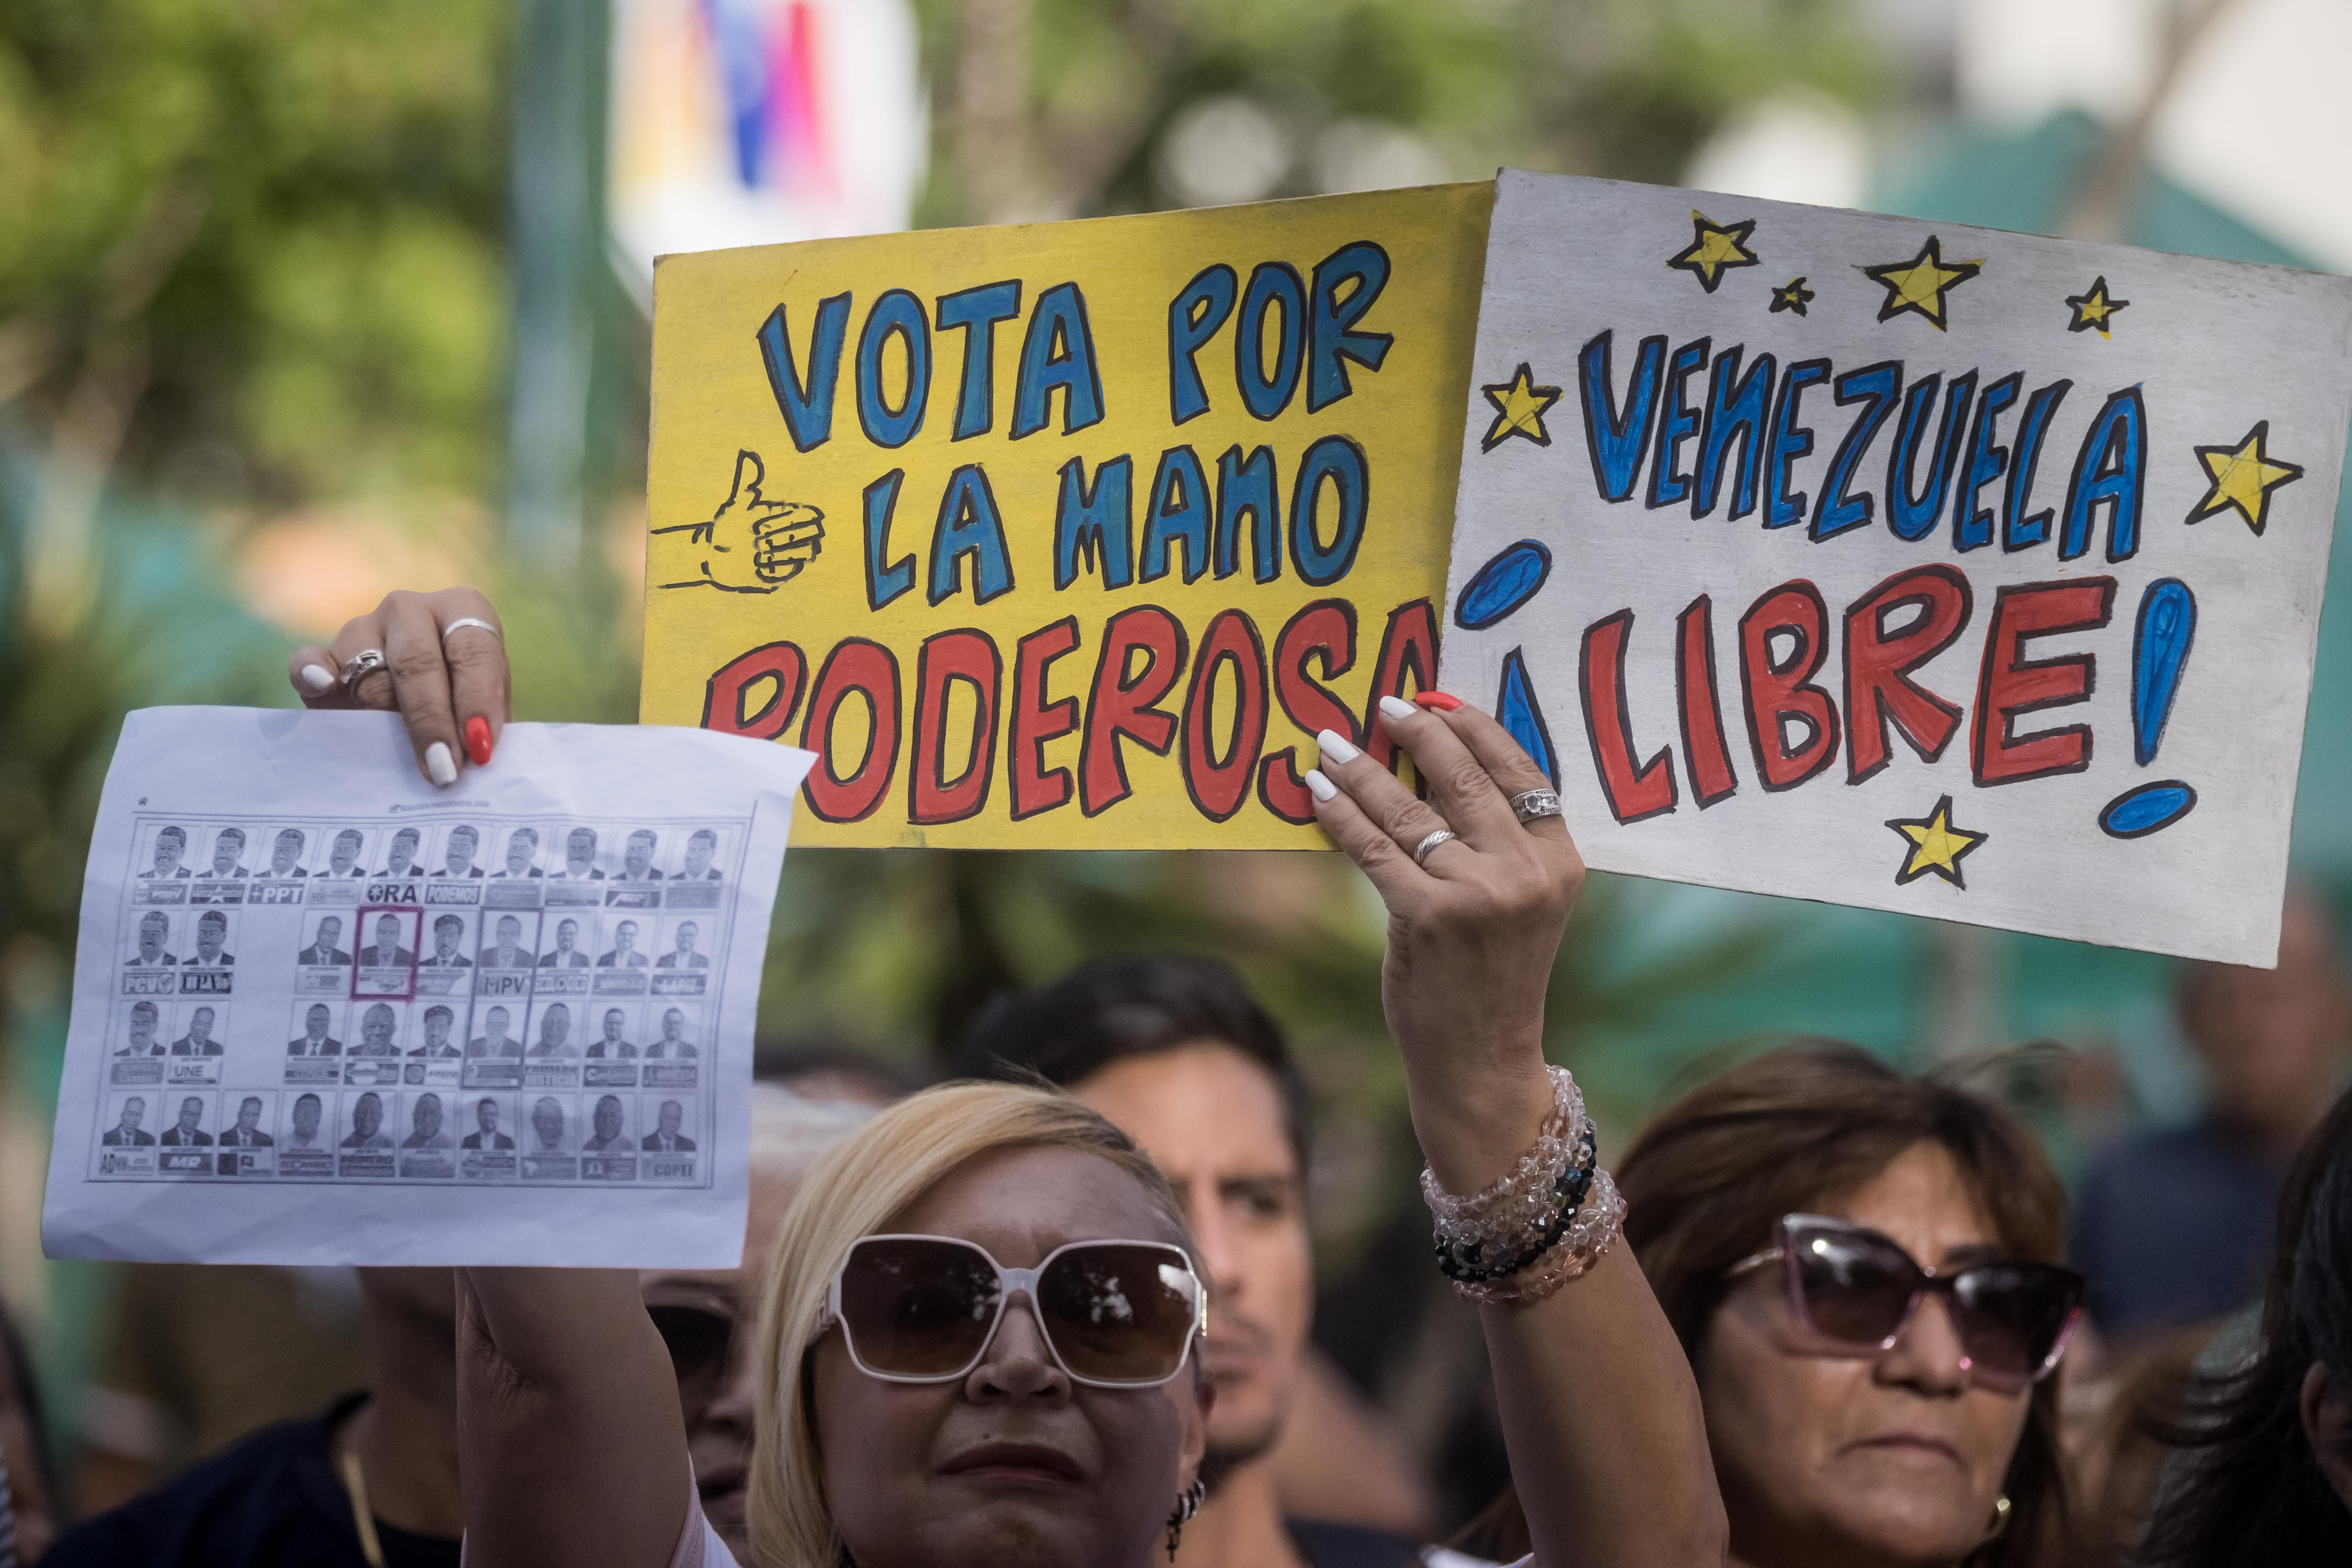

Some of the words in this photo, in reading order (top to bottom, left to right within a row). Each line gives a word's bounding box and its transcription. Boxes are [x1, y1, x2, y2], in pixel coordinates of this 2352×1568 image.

[757, 279, 1105, 453] VOTA
[1168, 240, 1395, 426] POR
[1578, 328, 2148, 565] VENEZUELA
[862, 463, 1016, 612] LA
[1053, 434, 1371, 593] MANO
[262, 887, 303, 904] PPT
[484, 977, 525, 995] MPV
[174, 1066, 204, 1077] UNE
[654, 1163, 692, 1178] COPEI
